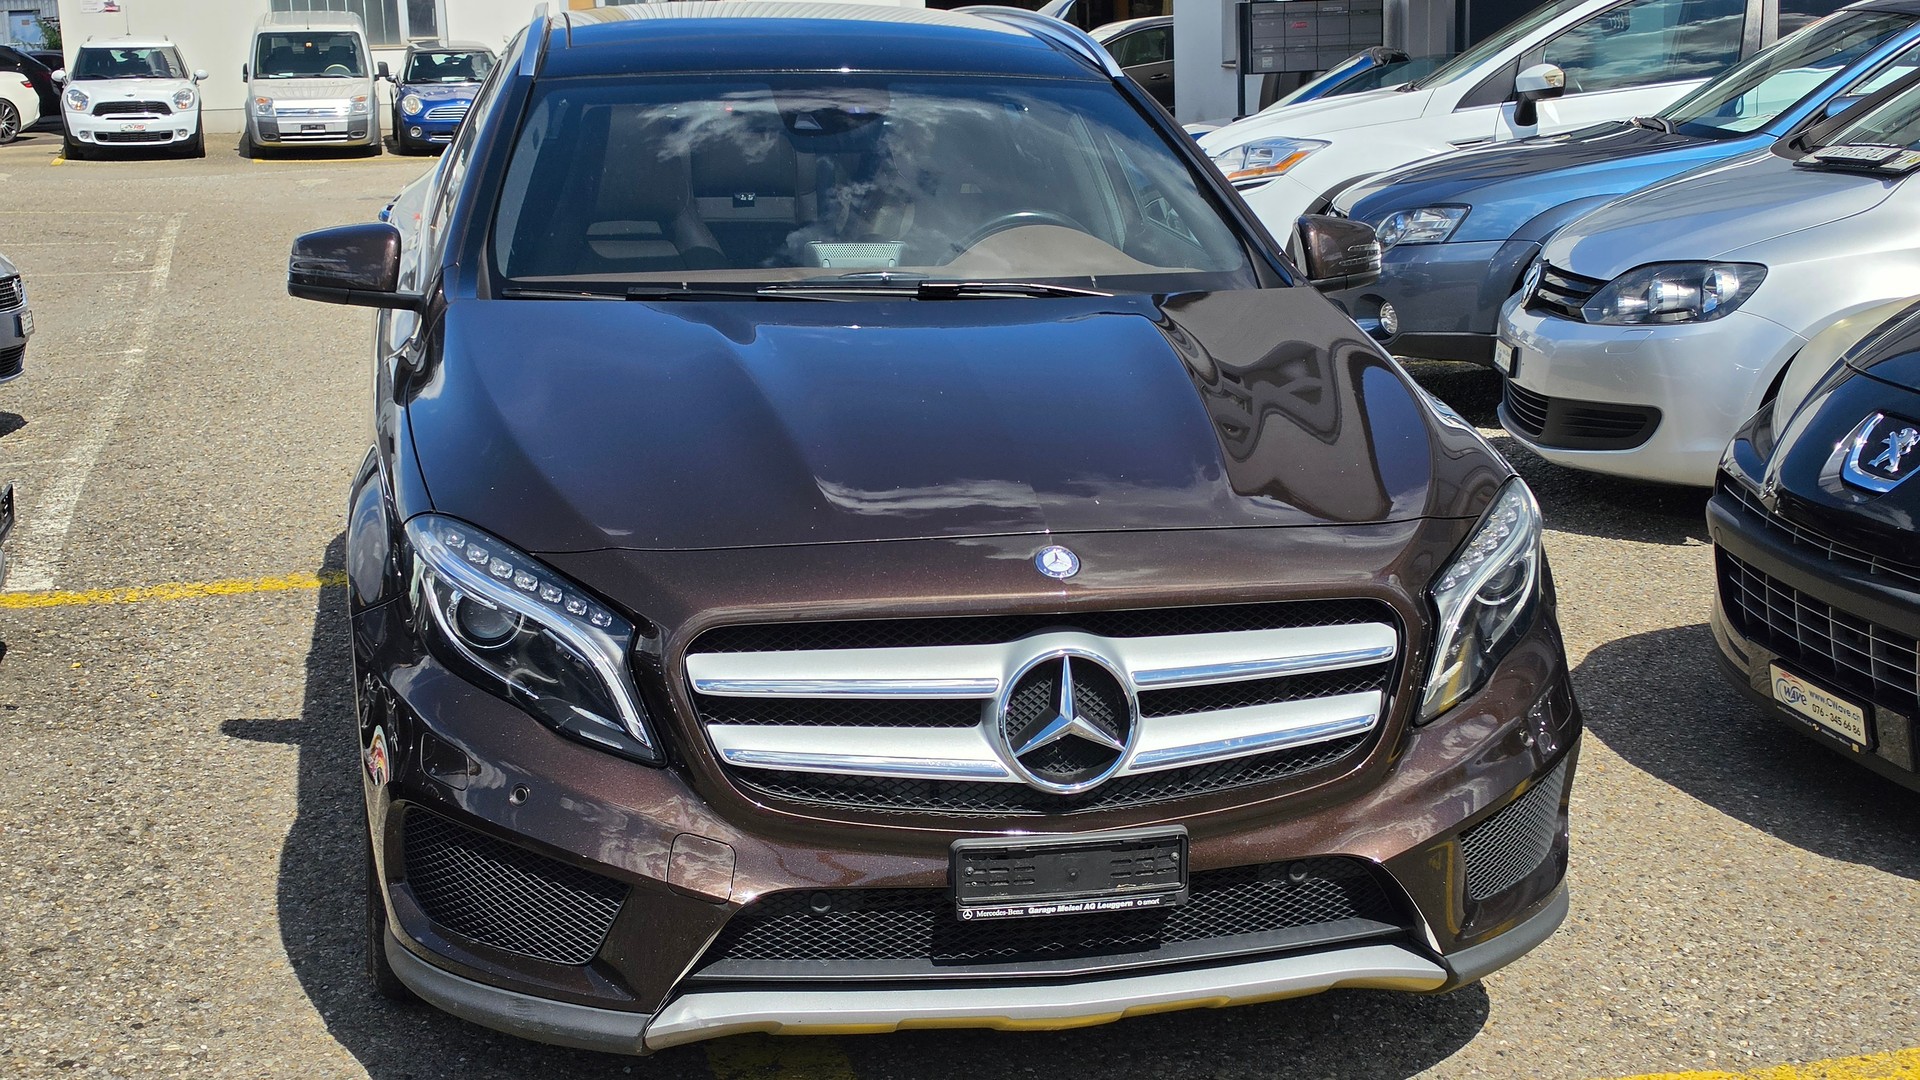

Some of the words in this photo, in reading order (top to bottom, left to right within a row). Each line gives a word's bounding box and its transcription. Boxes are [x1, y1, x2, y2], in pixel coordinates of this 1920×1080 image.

[1812, 703, 1825, 717] 076
[1829, 712, 1843, 726] 345
[1028, 906, 1056, 915] Garage
[1084, 902, 1096, 911] AG
[1097, 900, 1133, 910] Leuggern
[1143, 898, 1160, 906] smart
[976, 908, 1024, 918] Mercedes-Benz
